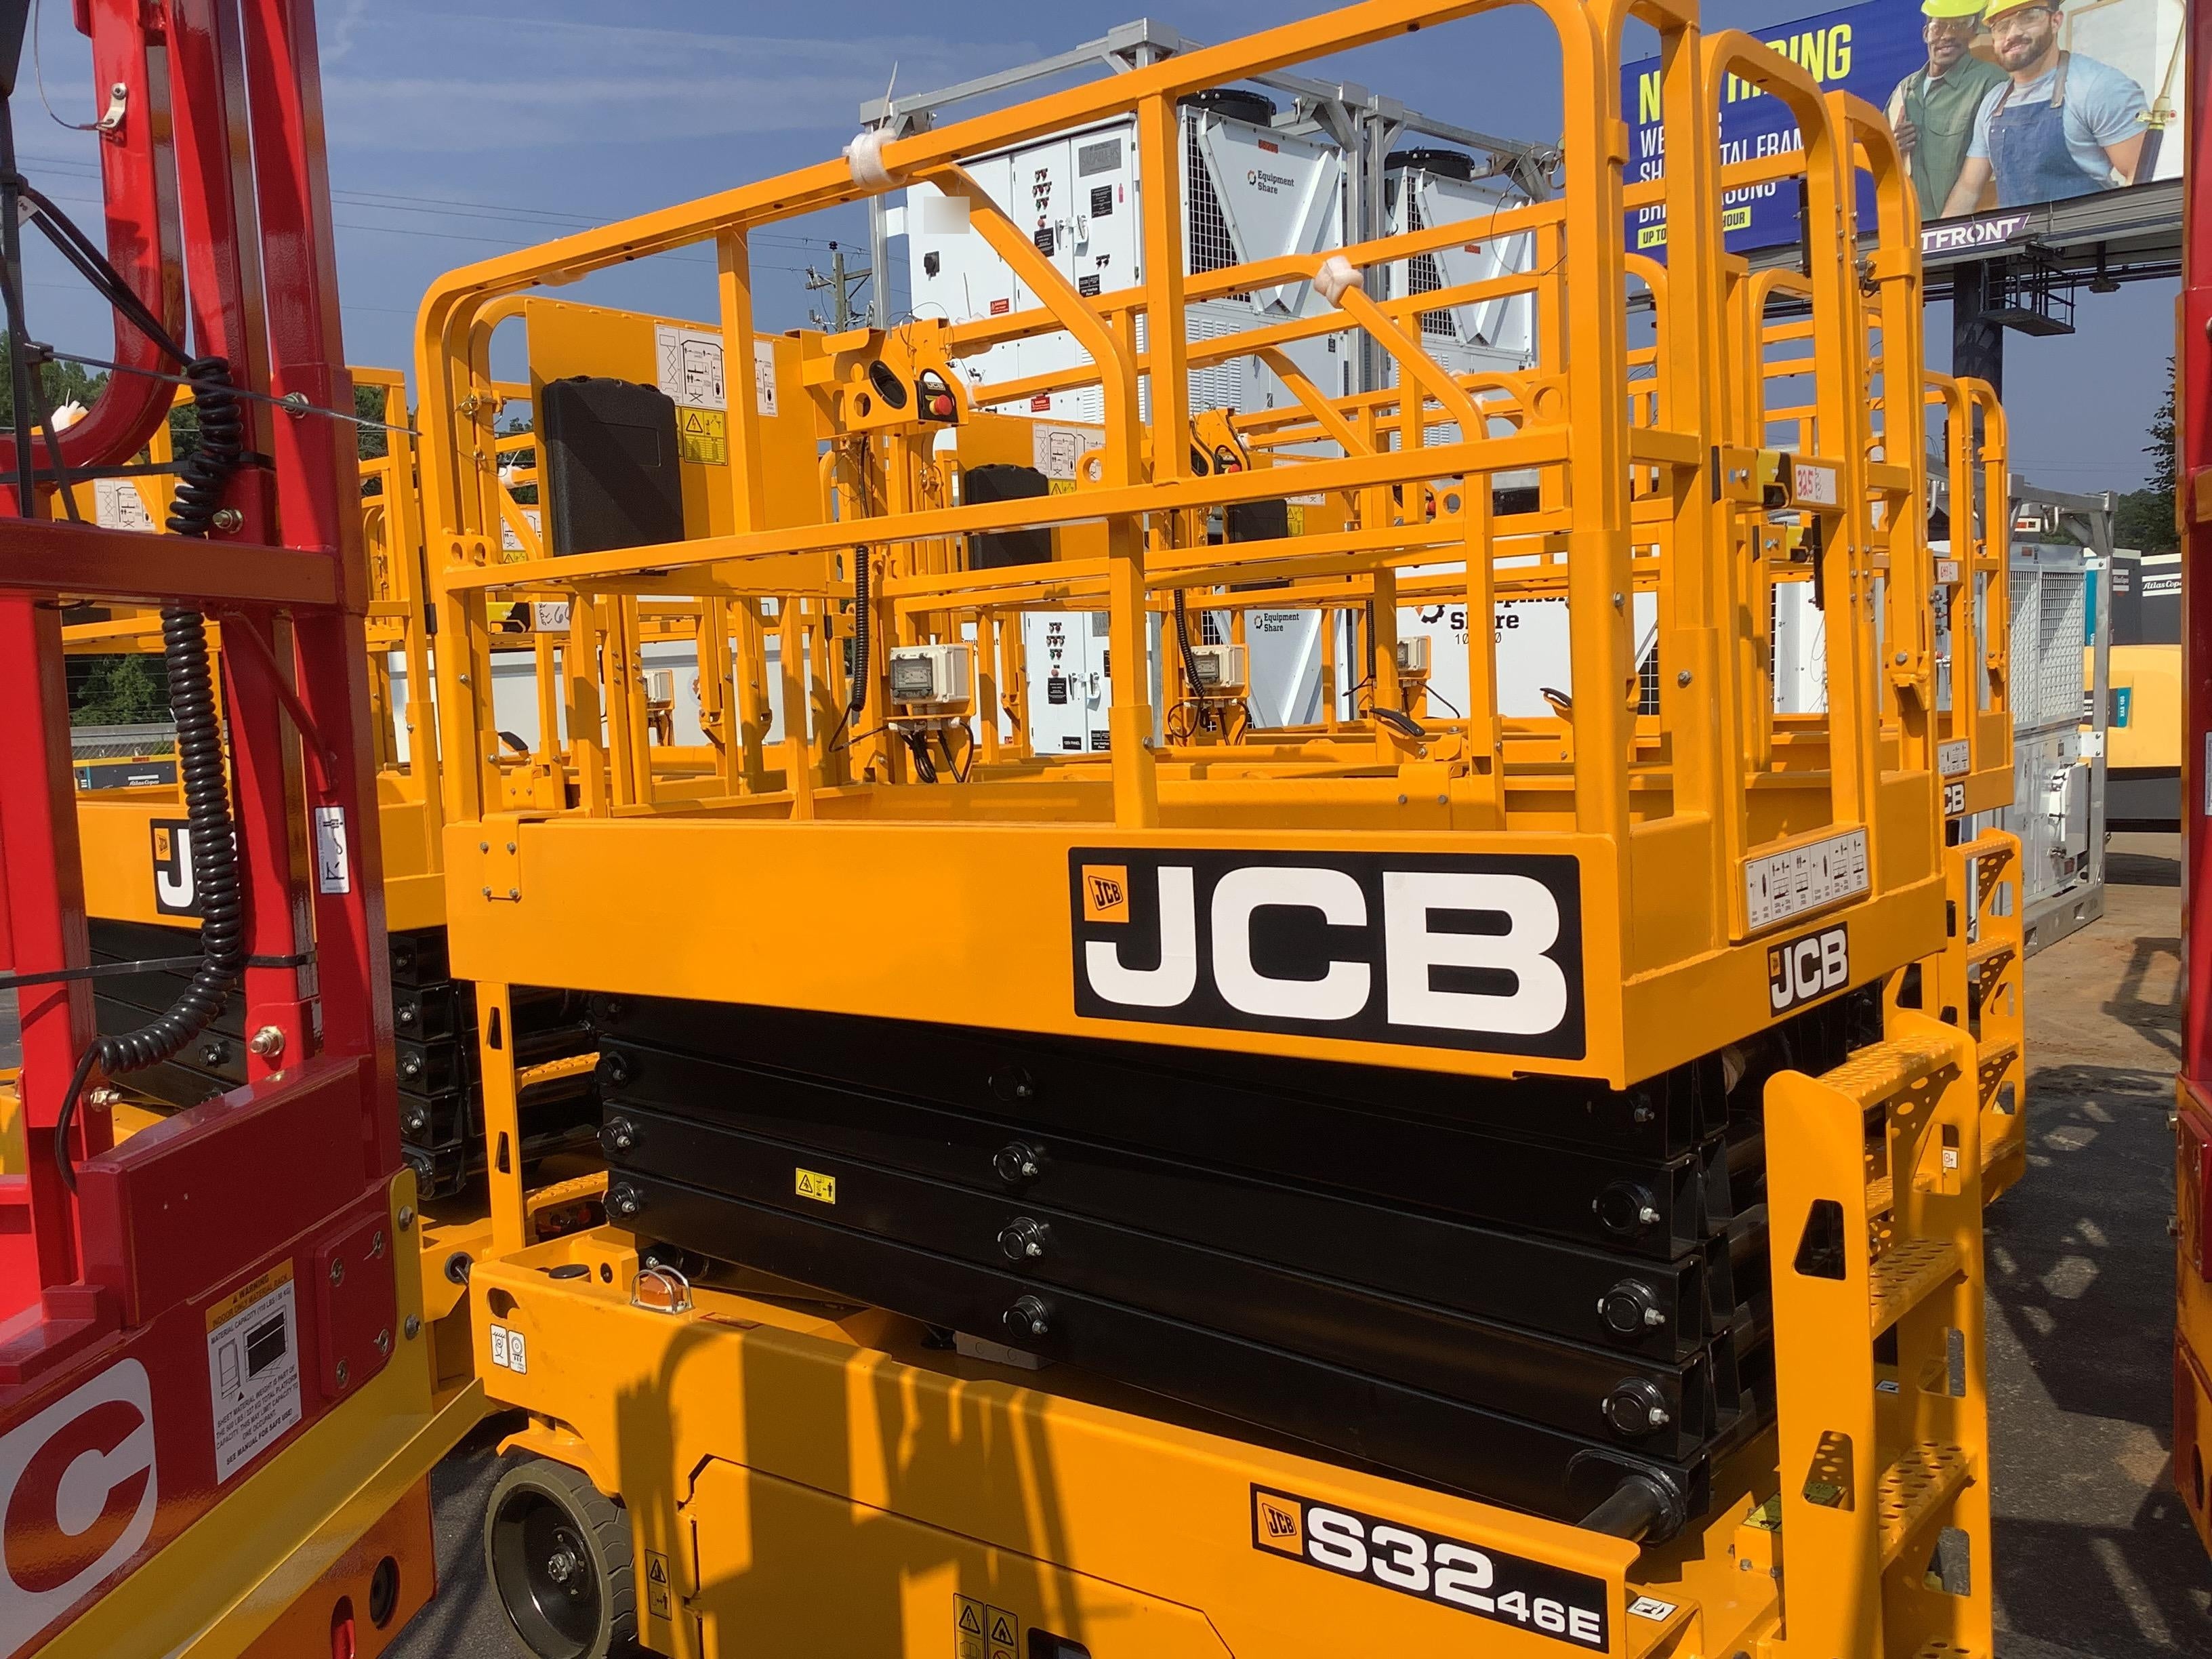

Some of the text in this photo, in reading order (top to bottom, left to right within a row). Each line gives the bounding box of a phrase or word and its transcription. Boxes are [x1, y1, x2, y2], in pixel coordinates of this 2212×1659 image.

[1258, 170, 1294, 186] Equipment
[1258, 182, 1277, 194] Share
[1643, 231, 1654, 243] UP
[1921, 218, 2021, 251] TFRONT
[1264, 613, 1299, 623] Equipment
[1450, 611, 1519, 630] Sre
[1944, 785, 1965, 814] CB
[1094, 880, 1122, 907] JCB
[1085, 866, 1567, 1035] JCB
[1771, 929, 1847, 1008] JCB
[239, 1273, 269, 1299] WARNING
[211, 1324, 233, 1345] MATERIAL
[234, 1309, 256, 1329] CAPACITY
[272, 1386, 291, 1406] CAPACITY
[276, 1372, 297, 1393] PLATFORM
[218, 1411, 232, 1428] SHEET
[234, 1394, 255, 1416] MATERIAL
[255, 1381, 272, 1399] WEIGHT
[226, 1452, 236, 1466] SEE
[237, 1435, 257, 1456] MANUAL
[258, 1427, 268, 1439] FOR
[269, 1416, 281, 1431] SAFE
[1268, 1507, 1601, 1643] JCB S32 46E
